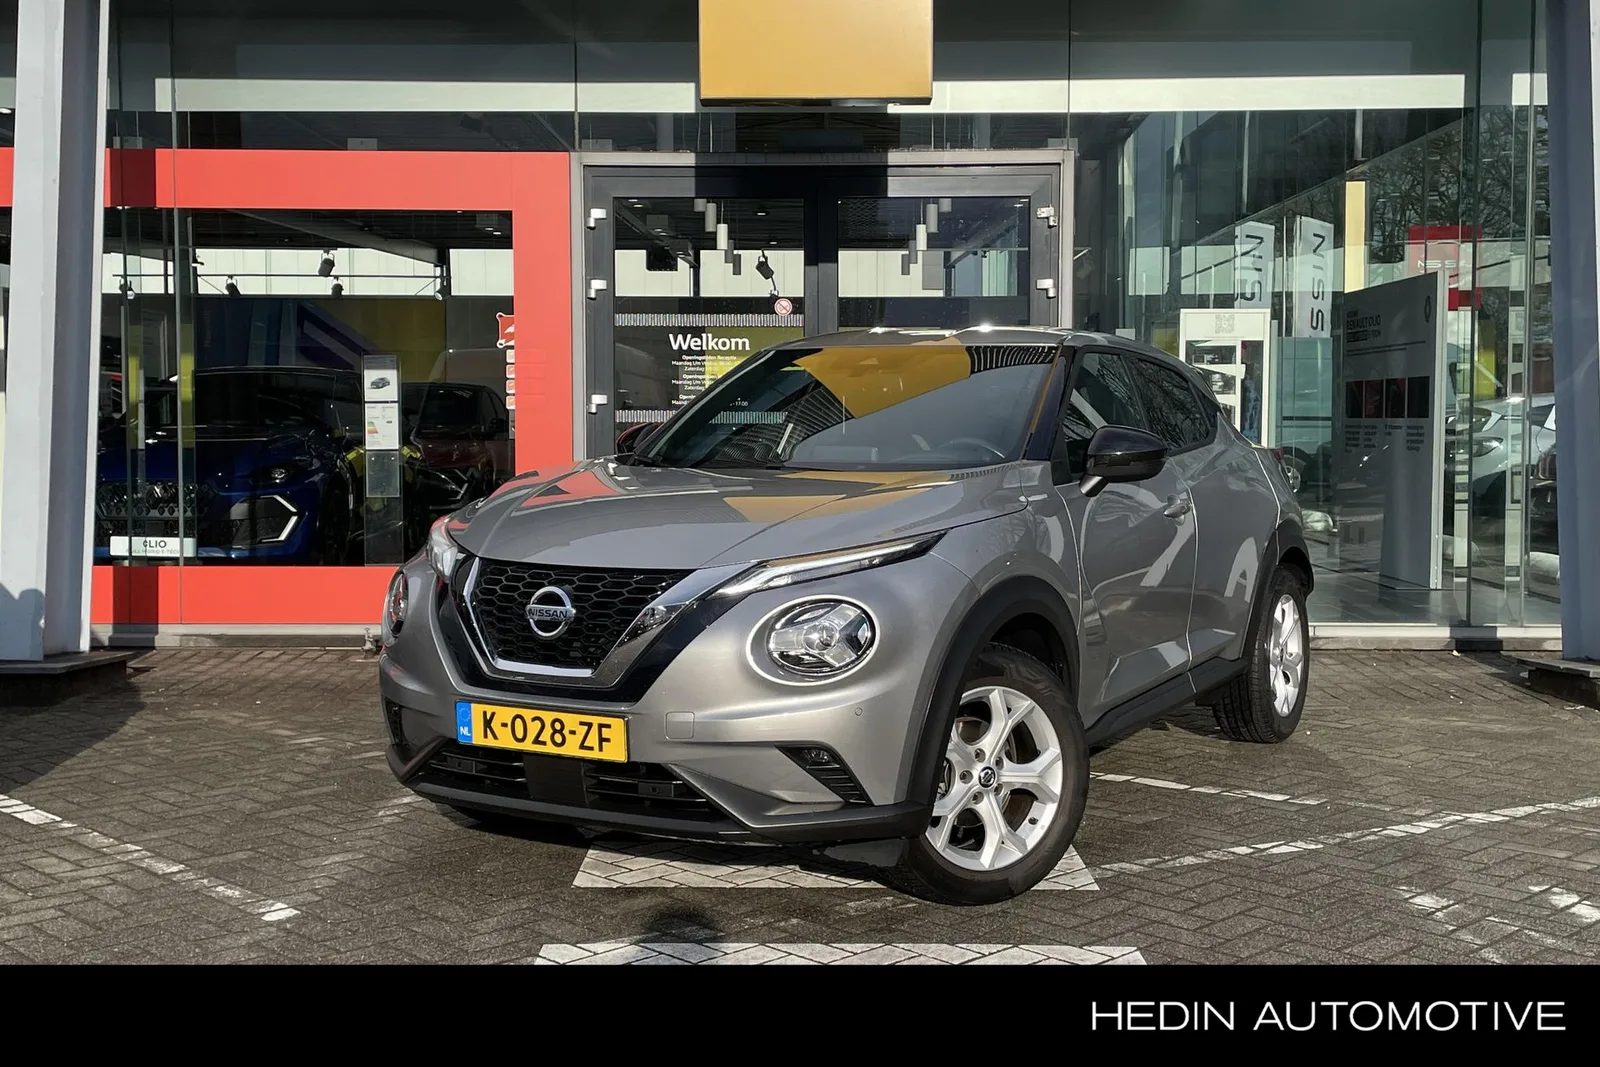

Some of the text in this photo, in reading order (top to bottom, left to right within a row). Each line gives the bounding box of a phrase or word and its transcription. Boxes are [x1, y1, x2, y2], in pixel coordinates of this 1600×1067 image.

[669, 333, 750, 350] Welkom
[143, 540, 167, 548] CLIO
[526, 608, 569, 619] NISSAN
[459, 725, 471, 736] NL
[482, 710, 612, 752] K-028-ZF
